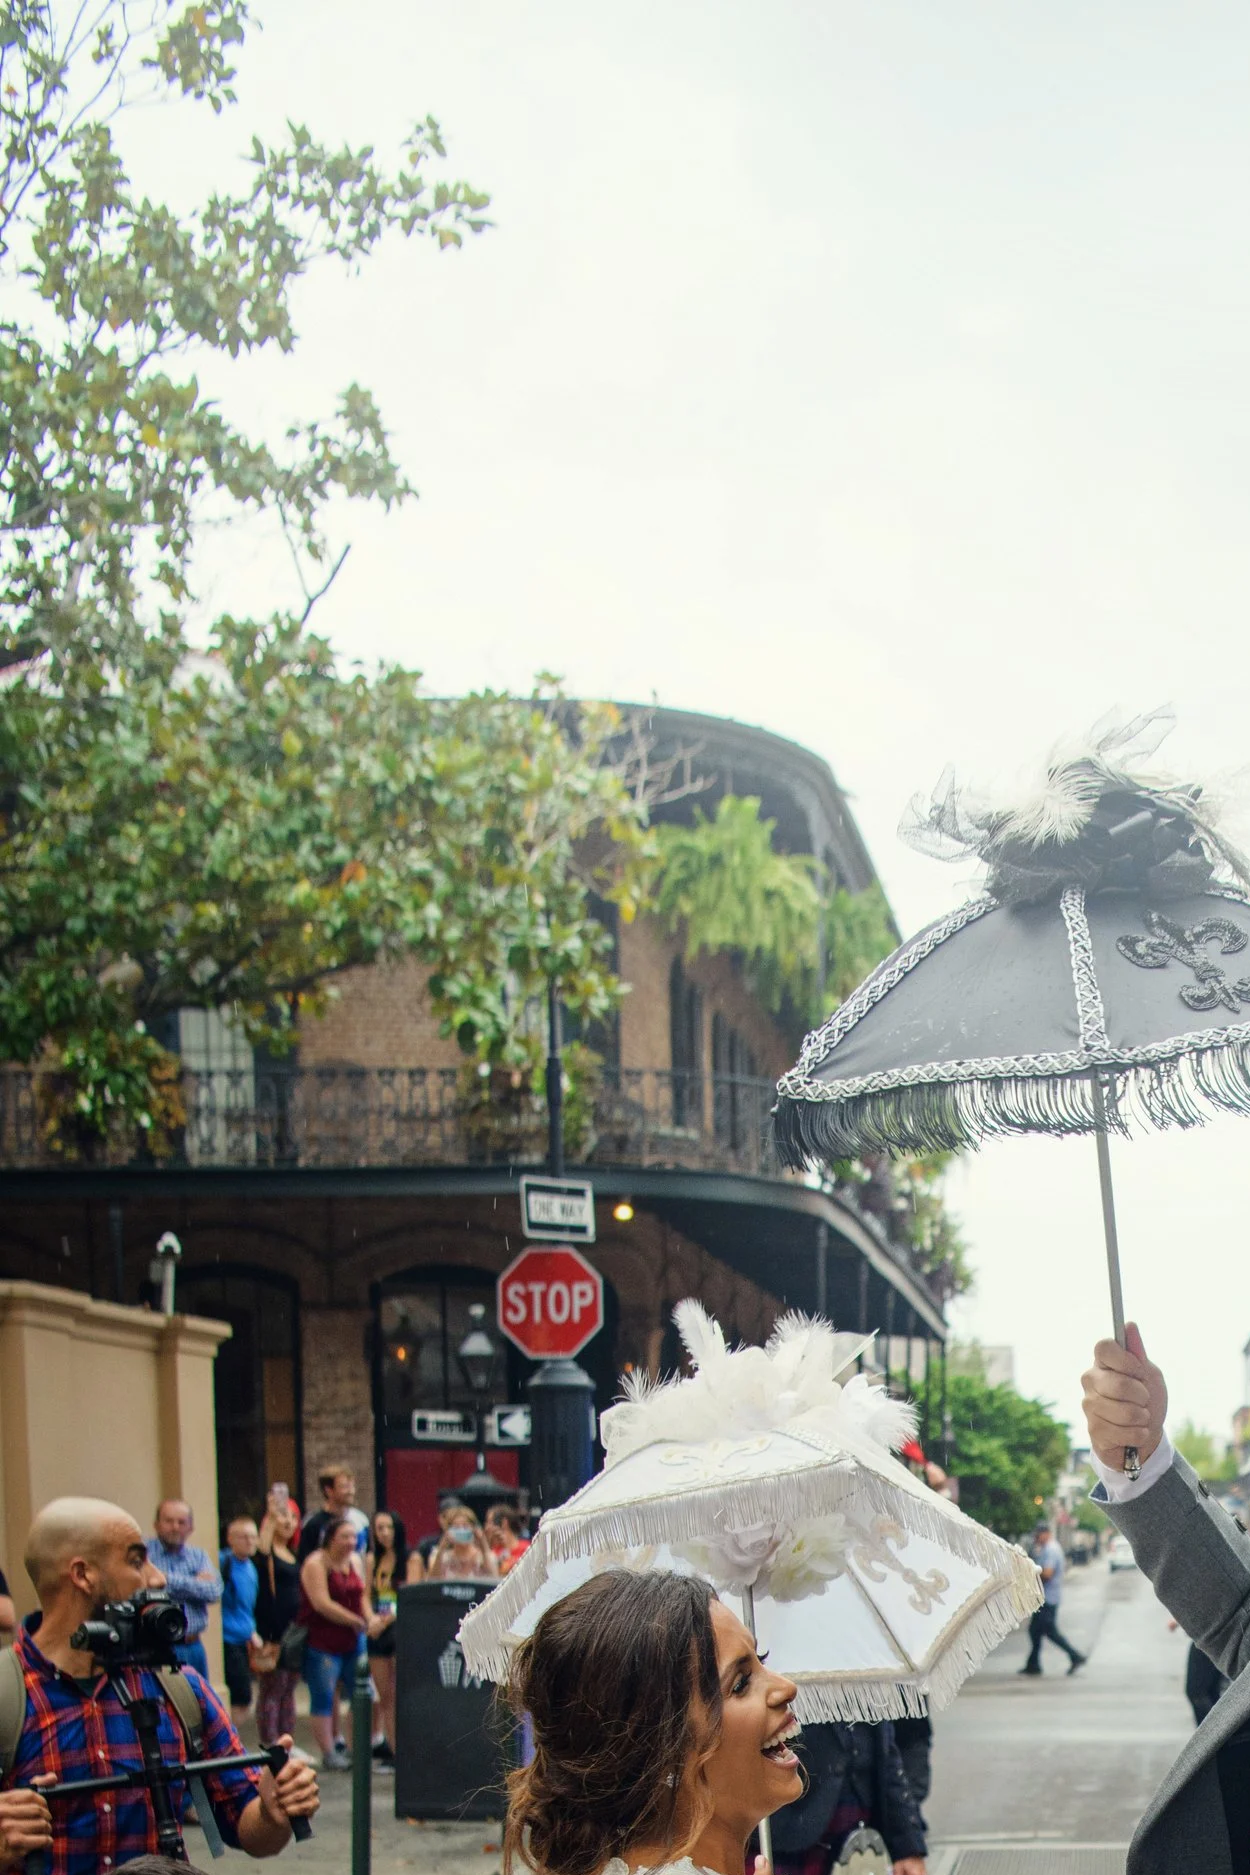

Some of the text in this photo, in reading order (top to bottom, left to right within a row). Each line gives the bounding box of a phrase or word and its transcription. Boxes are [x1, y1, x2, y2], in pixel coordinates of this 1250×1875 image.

[534, 1199, 585, 1218] ONE WAY
[506, 1281, 594, 1325] STOP
